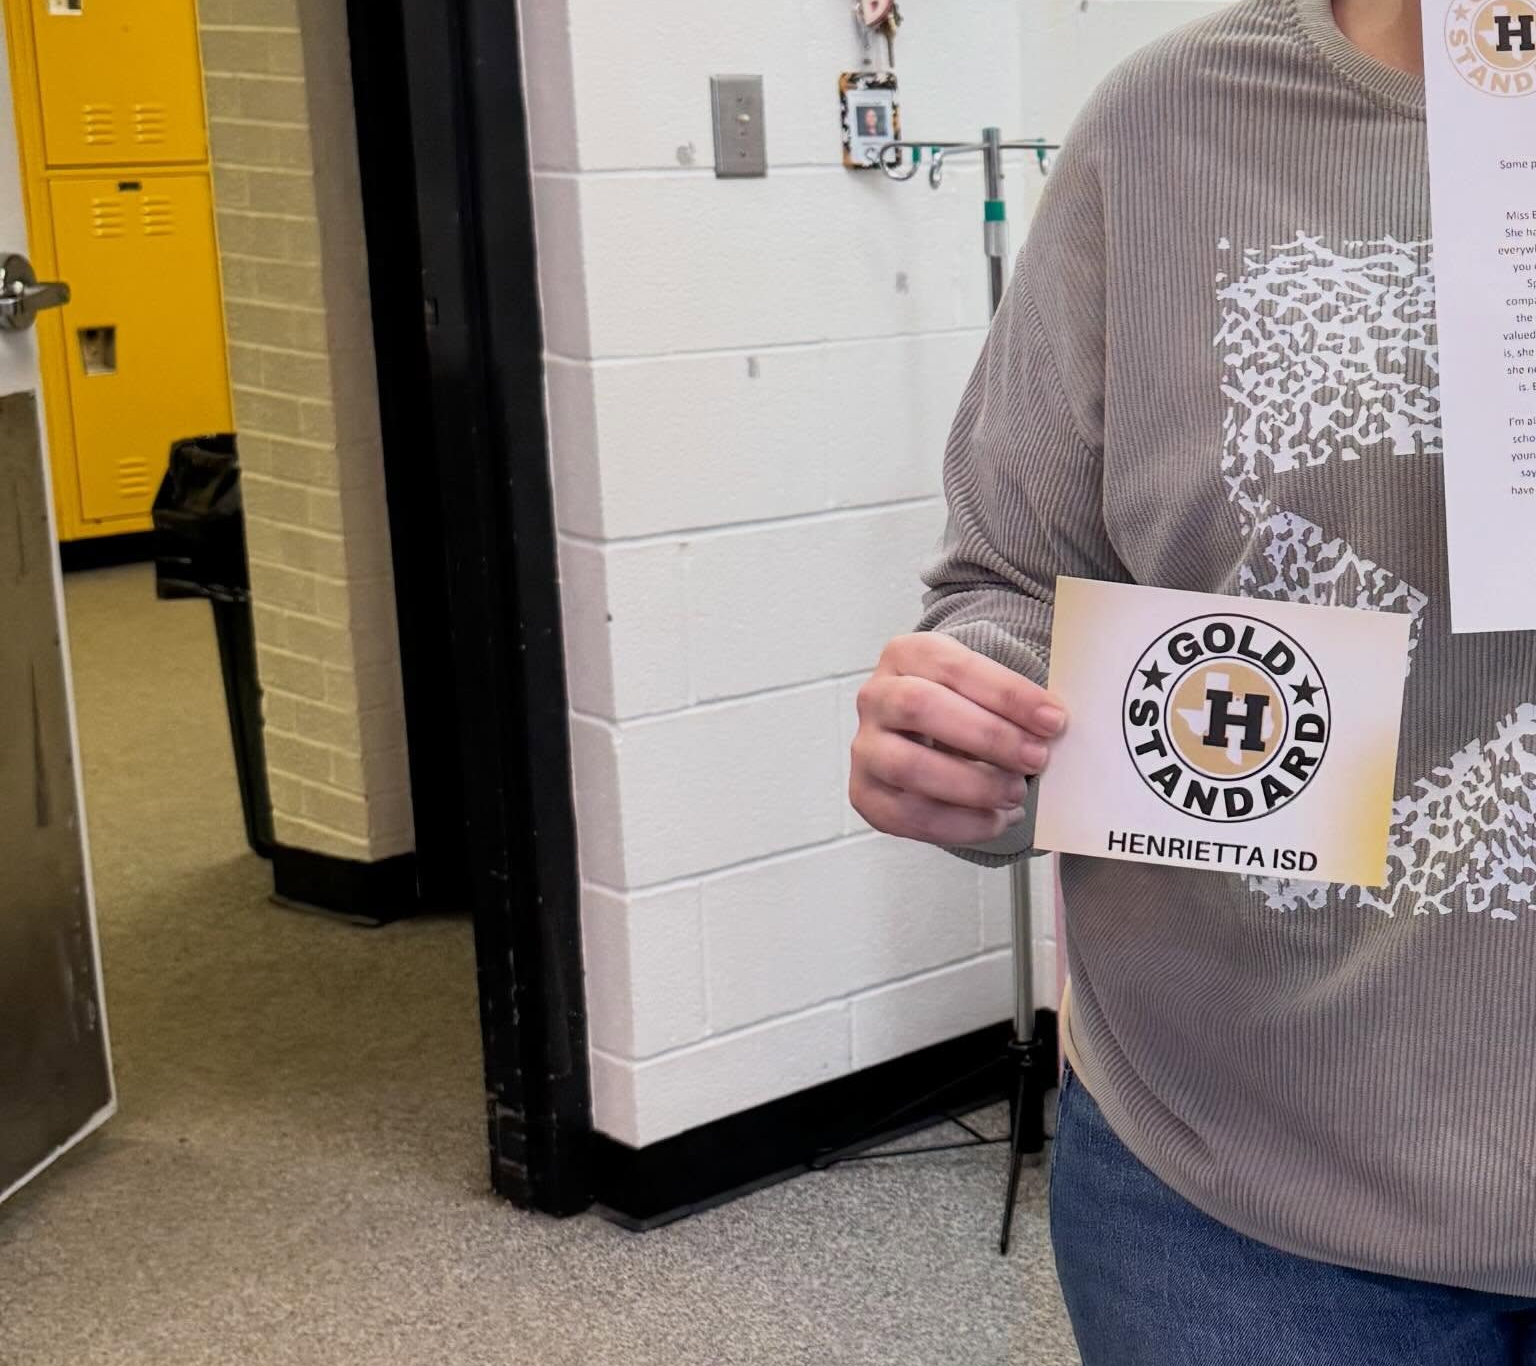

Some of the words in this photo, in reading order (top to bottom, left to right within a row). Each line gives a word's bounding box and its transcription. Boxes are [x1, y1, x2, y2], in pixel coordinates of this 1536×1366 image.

[1494, 15, 1536, 51] H
[1499, 159, 1529, 170] Some
[1506, 210, 1530, 221] Miss
[1511, 485, 1535, 495] have
[1166, 622, 1296, 677] GOLD
[1202, 688, 1270, 752] H
[1128, 698, 1325, 819] STANDARD
[1108, 830, 1265, 868] HENRIETTA
[1273, 848, 1318, 872] ISD
